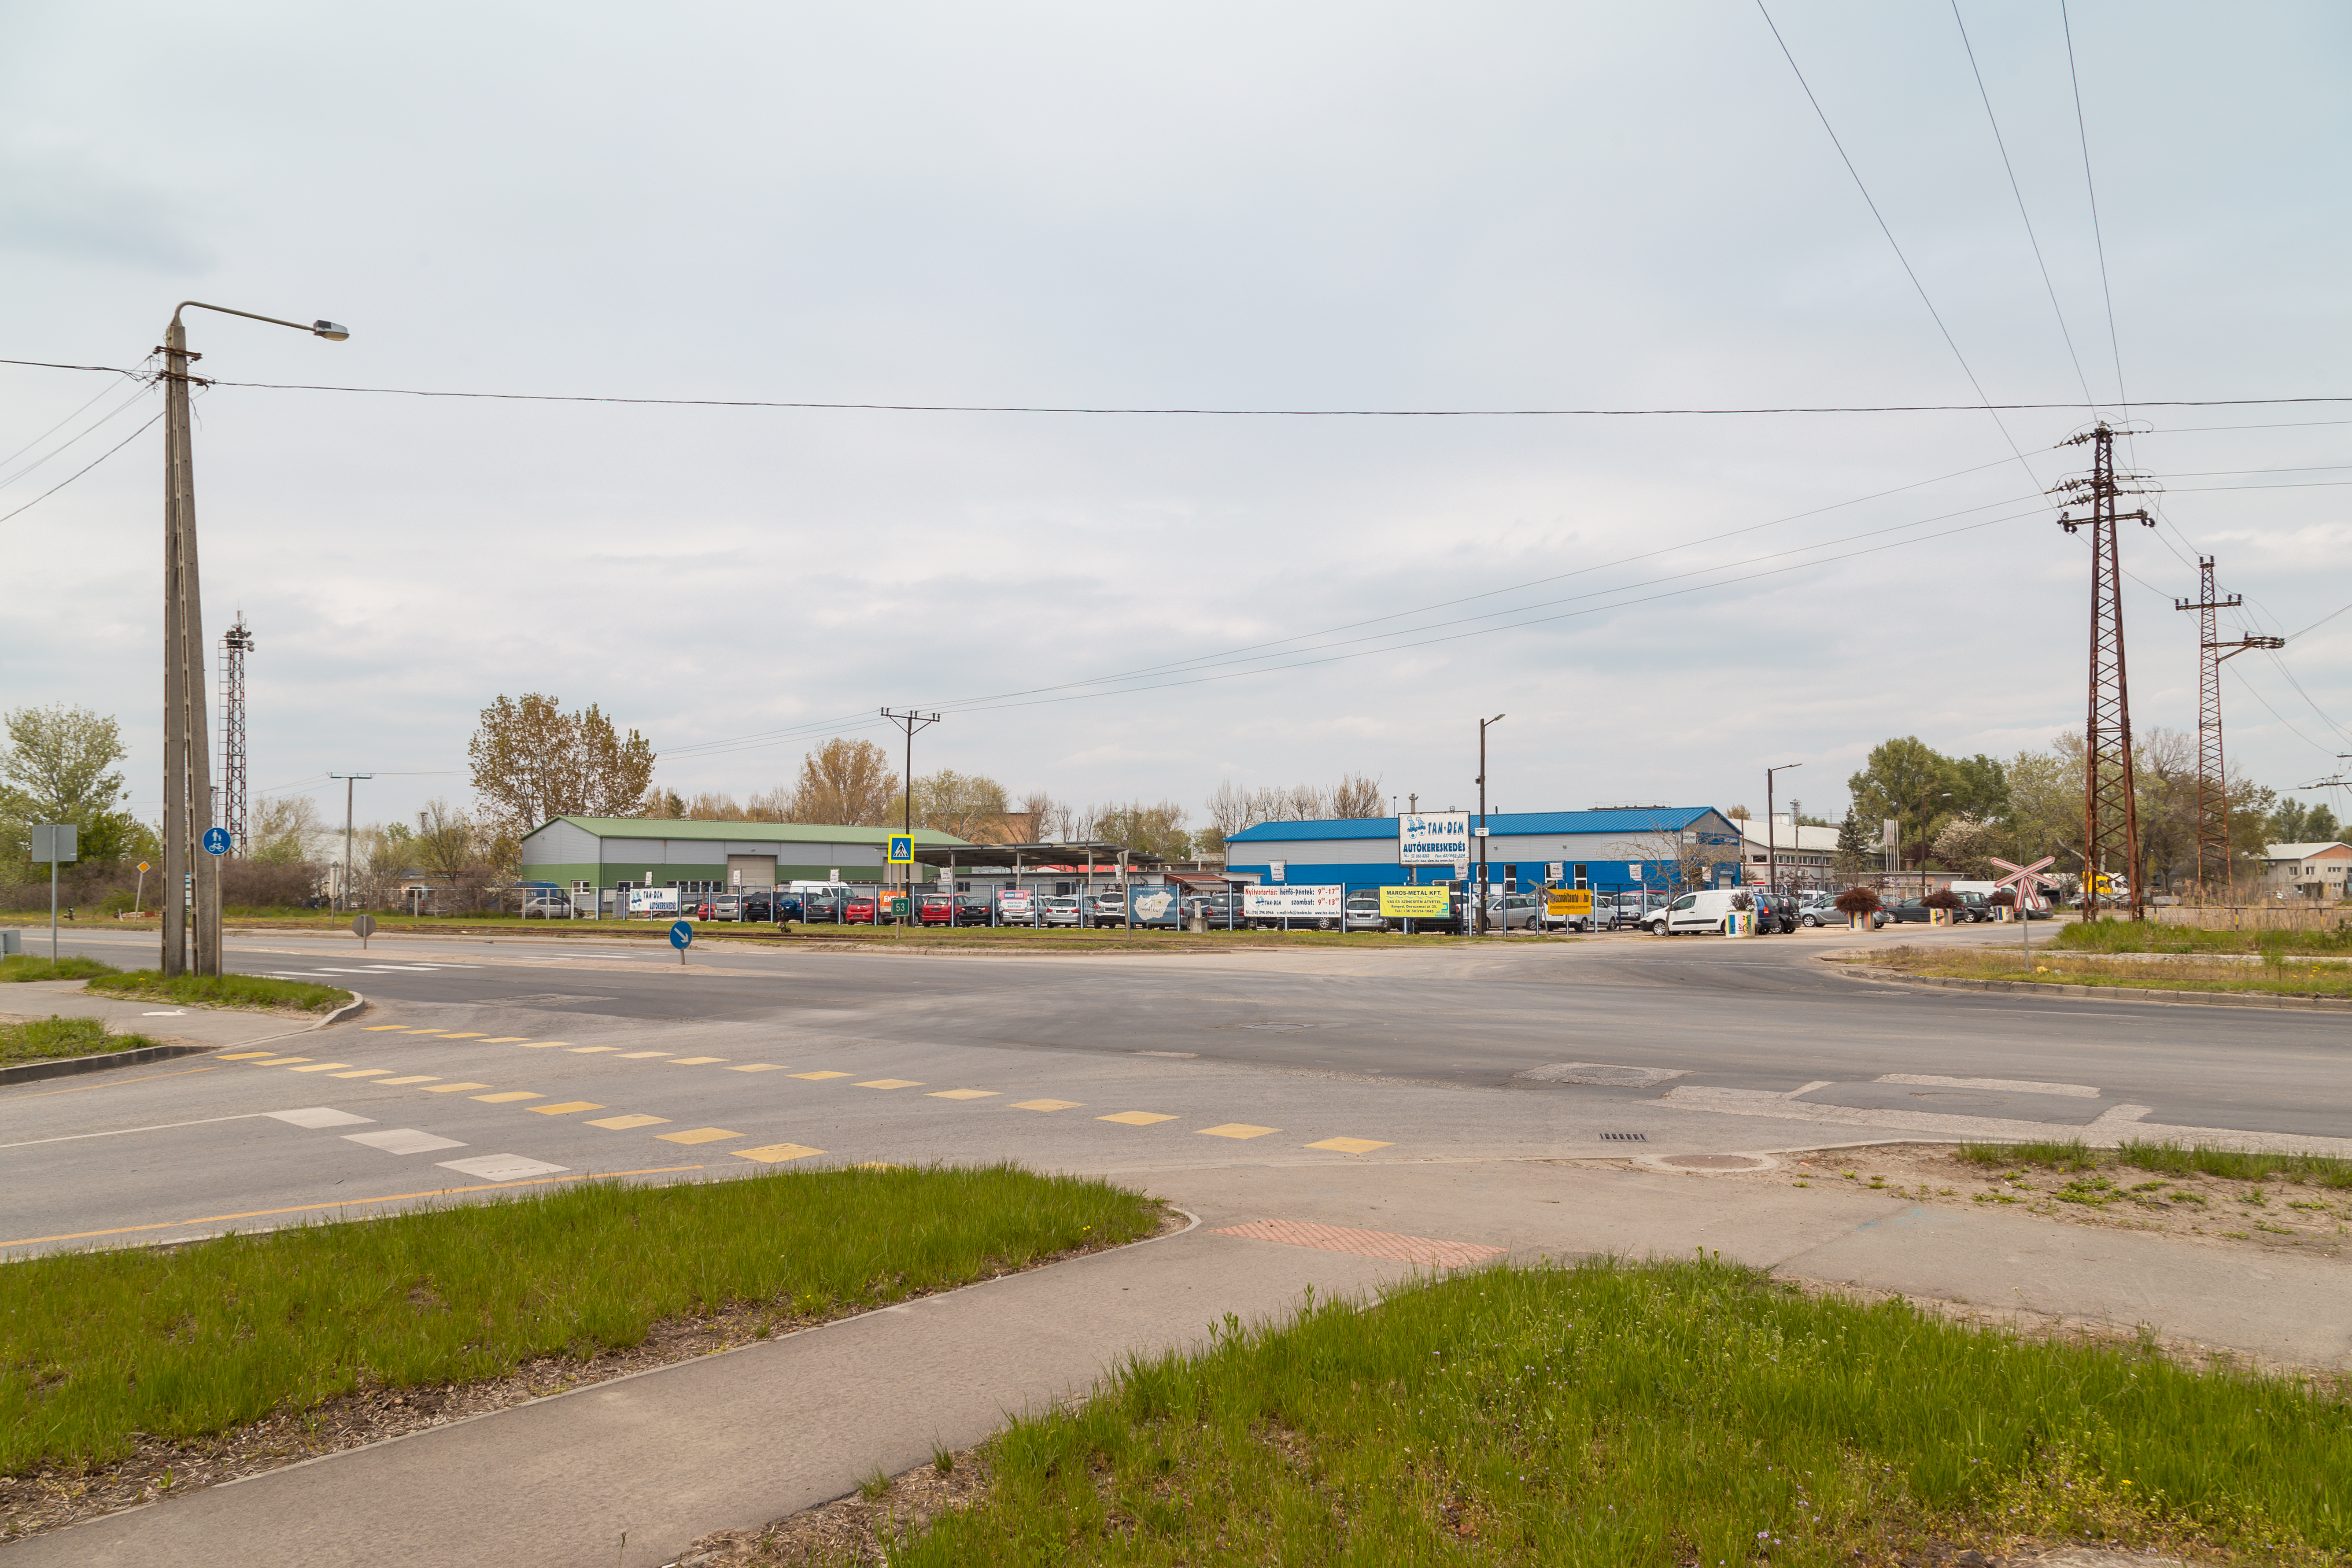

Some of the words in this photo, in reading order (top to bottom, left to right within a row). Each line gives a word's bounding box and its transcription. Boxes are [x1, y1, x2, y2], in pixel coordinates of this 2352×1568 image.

[1428, 821, 1464, 835] TAN-DEM
[1403, 841, 1466, 852] AUTÓKERESKEDÉS
[1245, 888, 1278, 897] Nyitvatartás:
[1280, 888, 1314, 896] hétfő-péntek:
[896, 903, 905, 911] 53
